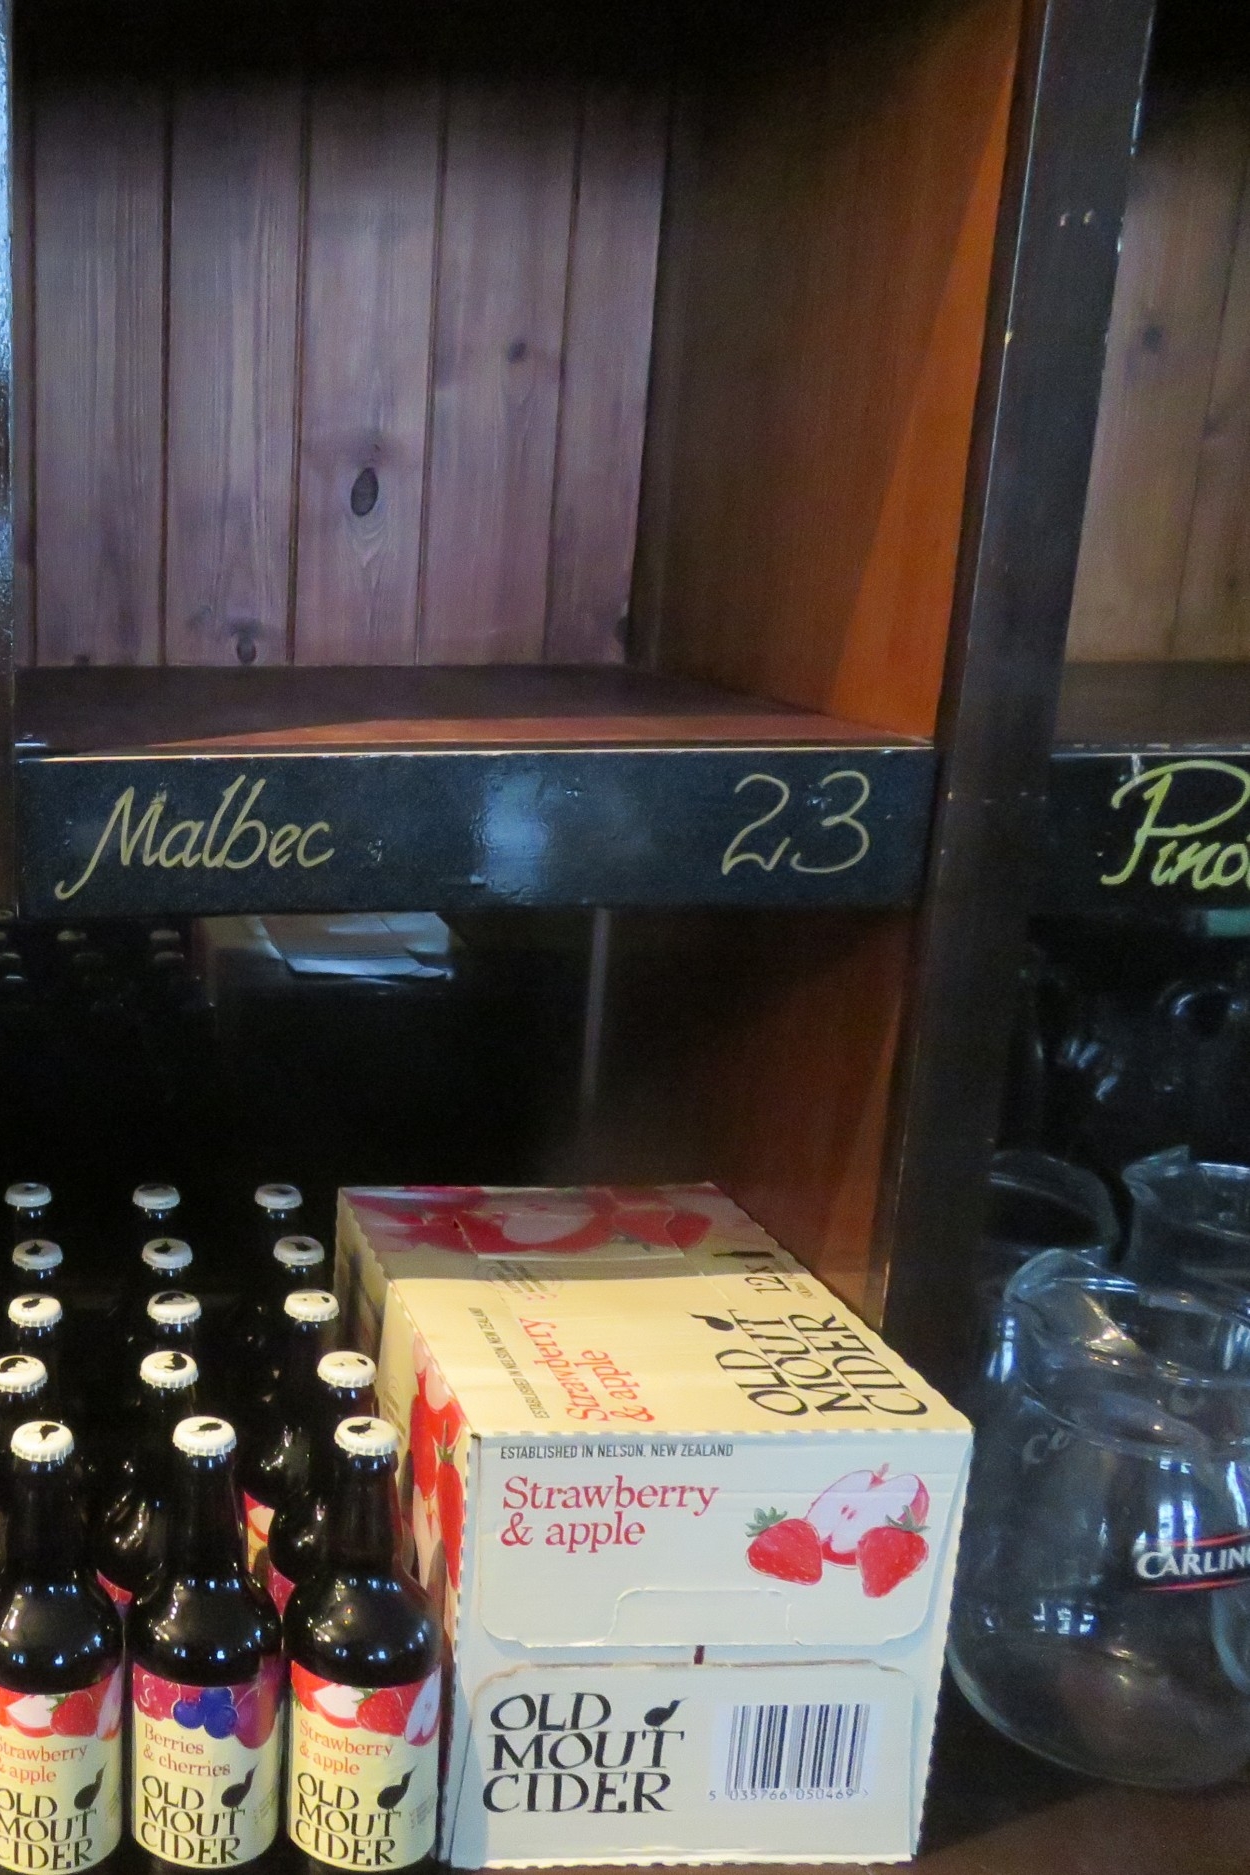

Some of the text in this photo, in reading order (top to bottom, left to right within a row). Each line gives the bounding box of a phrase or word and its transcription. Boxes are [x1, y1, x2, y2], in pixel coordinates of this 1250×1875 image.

[54, 770, 870, 900] Malbec 23
[519, 1317, 611, 1422] Strawberry
[715, 1348, 809, 1416] OLD
[727, 1308, 872, 1416] MOUT
[787, 1312, 928, 1416] CIDER
[574, 1349, 656, 1422] & apple
[500, 1445, 578, 1460] ESTABLISHED
[581, 1444, 594, 1459] IN
[650, 1443, 677, 1458] NEW
[680, 1443, 734, 1458] ZEALAND
[503, 1474, 720, 1517] Strawberry
[500, 1510, 646, 1554] & apple
[489, 1691, 612, 1732] OLD
[143, 1722, 205, 1756] Berries
[143, 1744, 232, 1778] & cherries
[299, 1718, 394, 1761] Strawberry
[299, 1741, 361, 1776] & apple
[487, 1728, 686, 1772] MOUT
[9, 1764, 57, 1786] apple
[141, 1775, 205, 1811] OLD
[297, 1771, 360, 1810] OLD
[482, 1770, 673, 1814] CIDER
[143, 1794, 246, 1838] MOUT
[299, 1791, 403, 1838] MOUT
[140, 1821, 241, 1866] CIDER
[294, 1818, 397, 1867] CIDER
